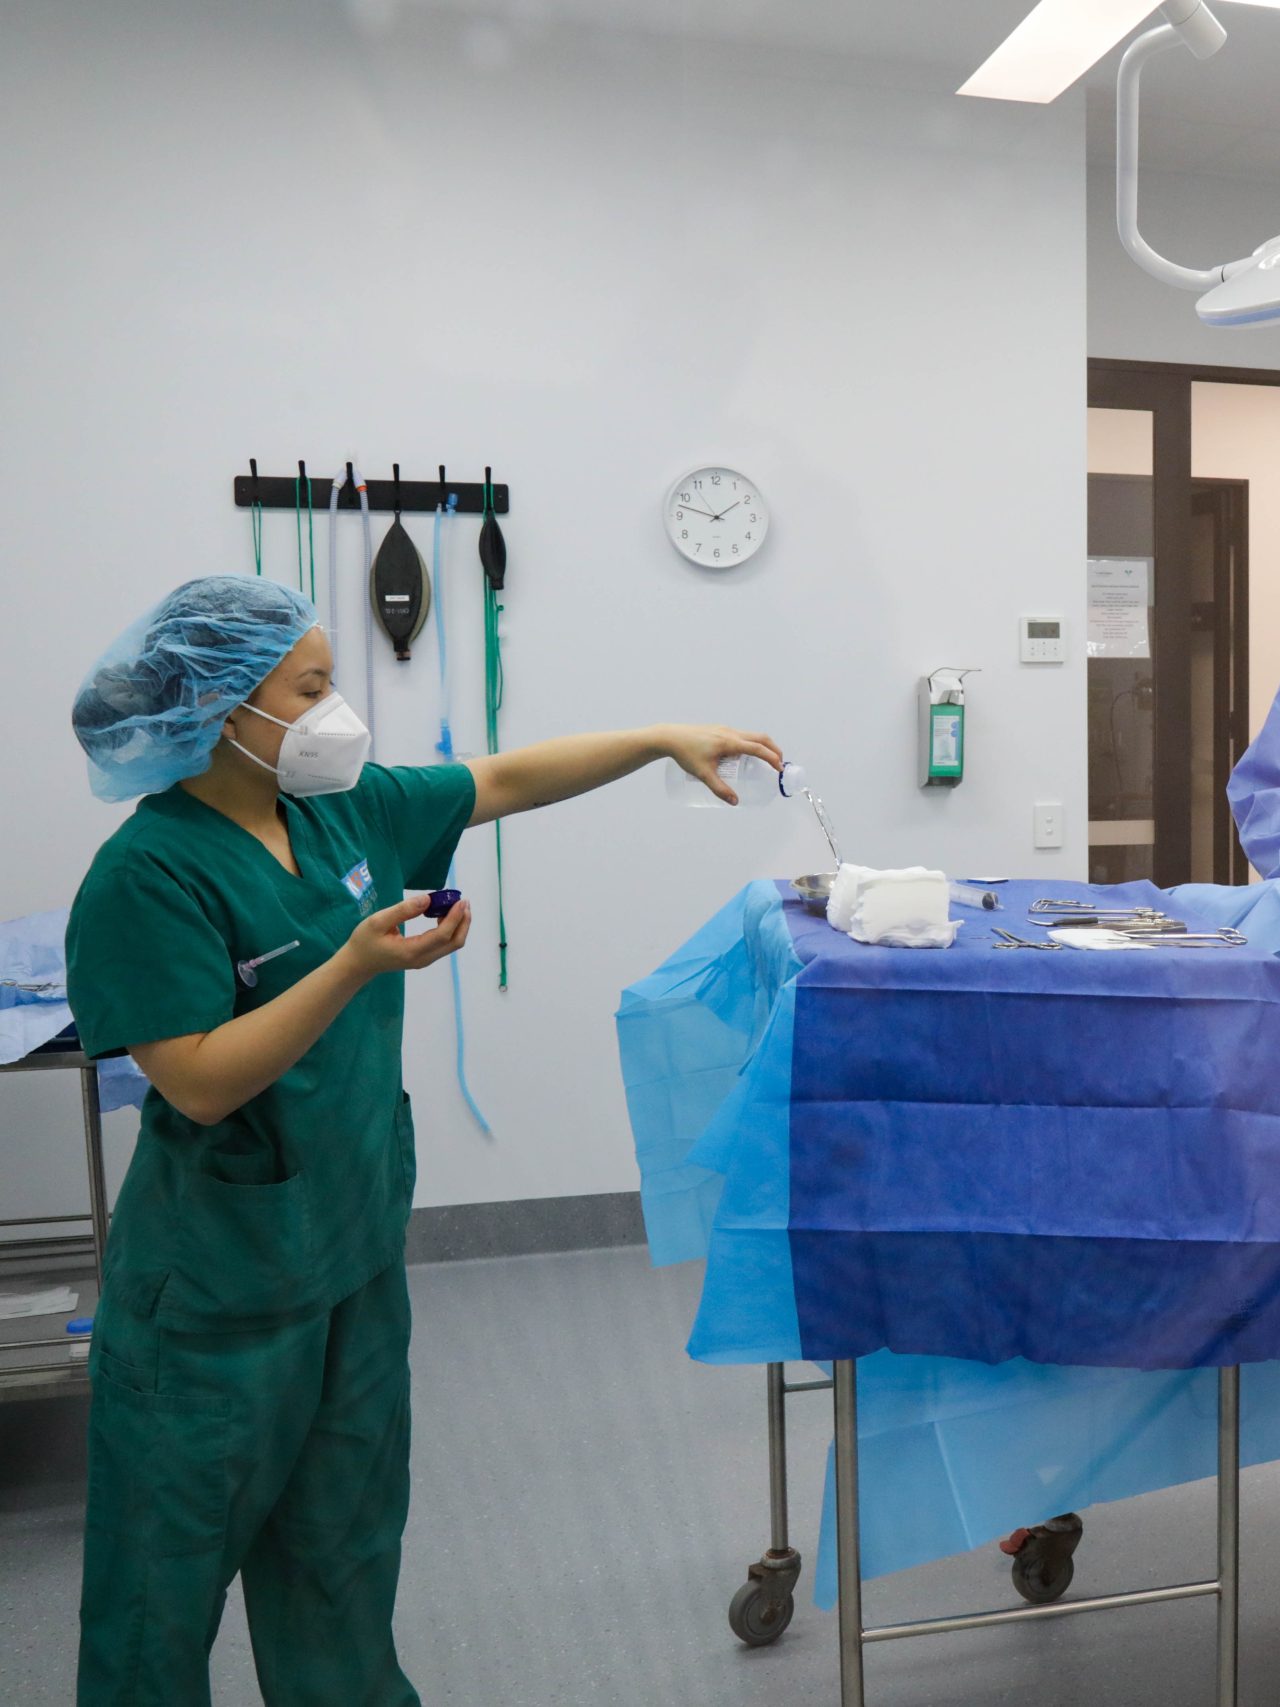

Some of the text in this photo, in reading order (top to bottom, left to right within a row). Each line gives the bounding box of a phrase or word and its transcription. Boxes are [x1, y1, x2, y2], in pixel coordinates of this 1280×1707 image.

[693, 480, 703, 490] 11
[711, 475, 721, 486] 12
[680, 492, 691, 503] 10
[744, 495, 751, 505] 2
[676, 511, 684, 521] 9
[750, 513, 757, 523] 3
[681, 529, 689, 539] 8
[745, 531, 752, 540] 4
[695, 543, 702, 553] 7
[713, 548, 720, 558] 6
[732, 544, 739, 554] 5
[298, 751, 319, 759] KN95
